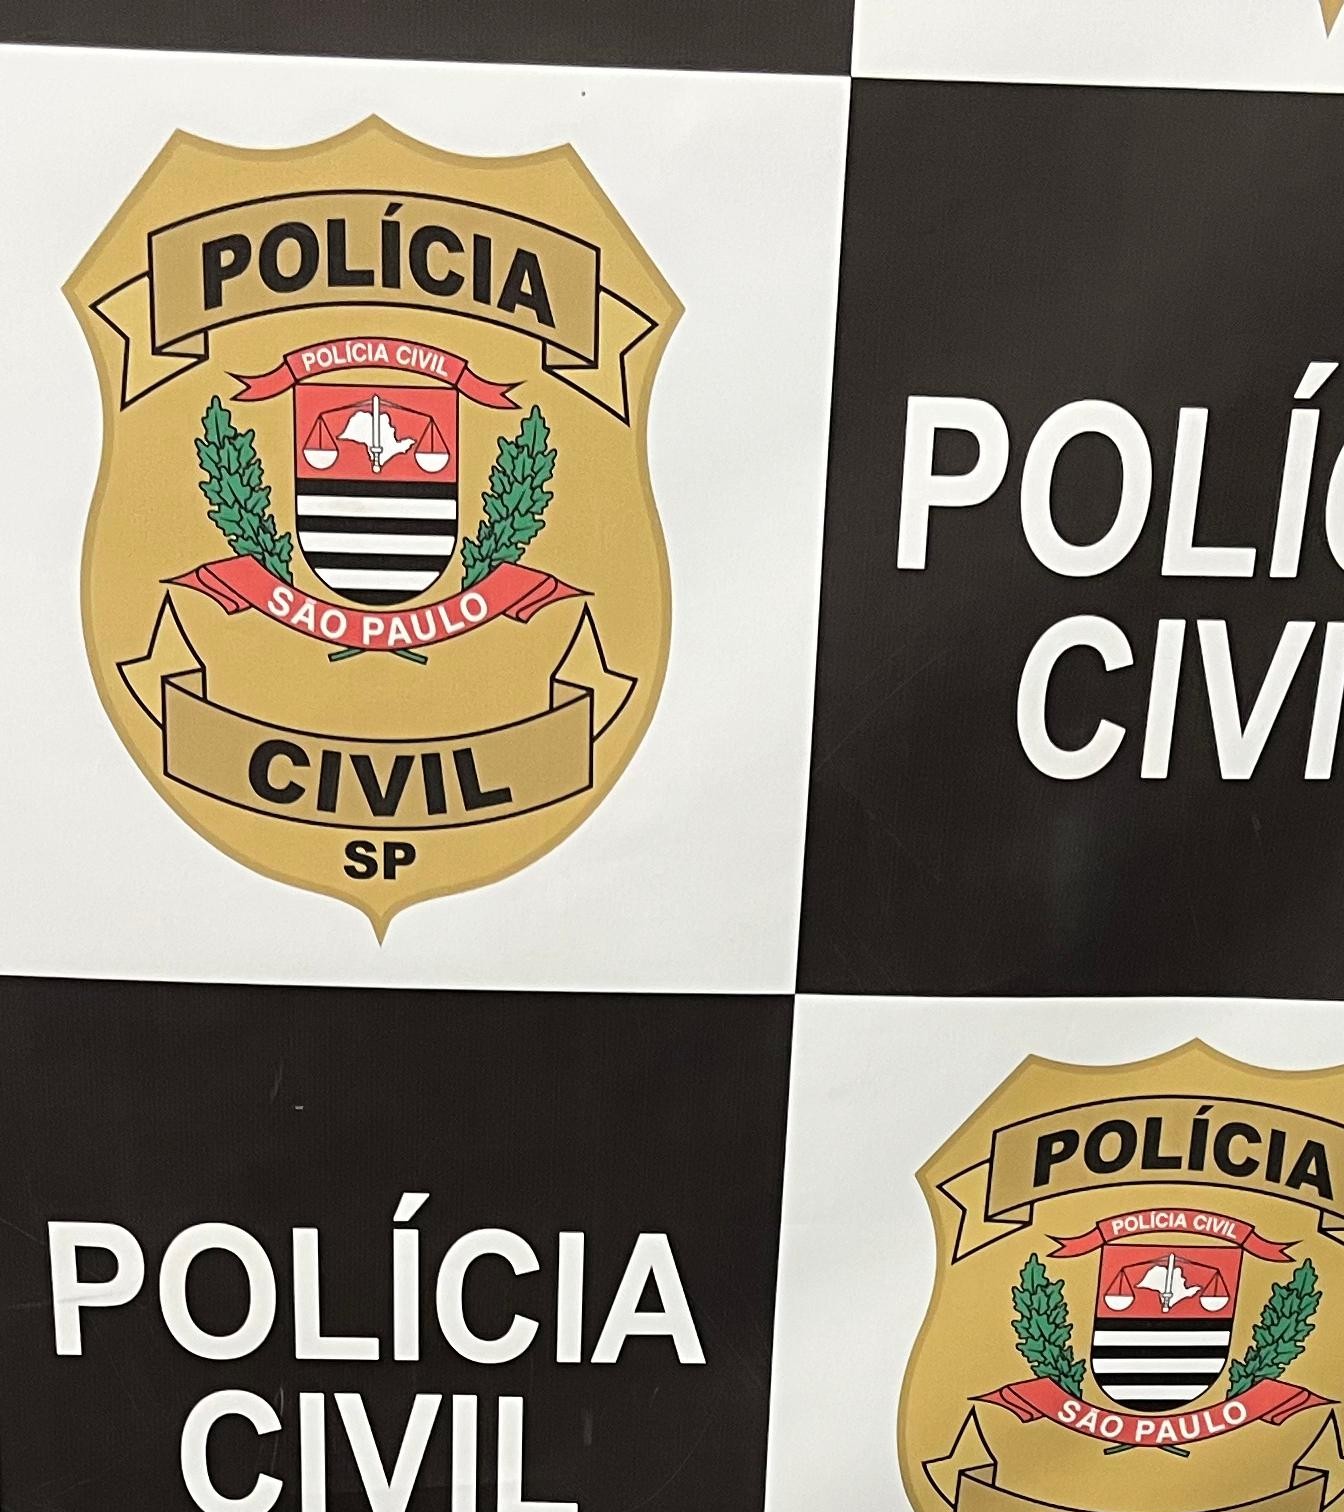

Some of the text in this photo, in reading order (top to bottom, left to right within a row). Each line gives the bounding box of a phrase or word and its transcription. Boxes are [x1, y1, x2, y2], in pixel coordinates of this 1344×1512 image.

[202, 203, 555, 328] POLÍCIA
[301, 341, 448, 377] POLÍCIA CIVIL
[267, 586, 488, 646] SÃO PAULO
[249, 740, 512, 816] CIVIL
[344, 841, 415, 880] SP
[1033, 1107, 1333, 1200] POLÍCIA
[1111, 1211, 1237, 1239] POLÍCIA CIVIL
[48, 1193, 706, 1364] POLÍCIA
[1057, 1400, 1247, 1443] SÃO PAULO
